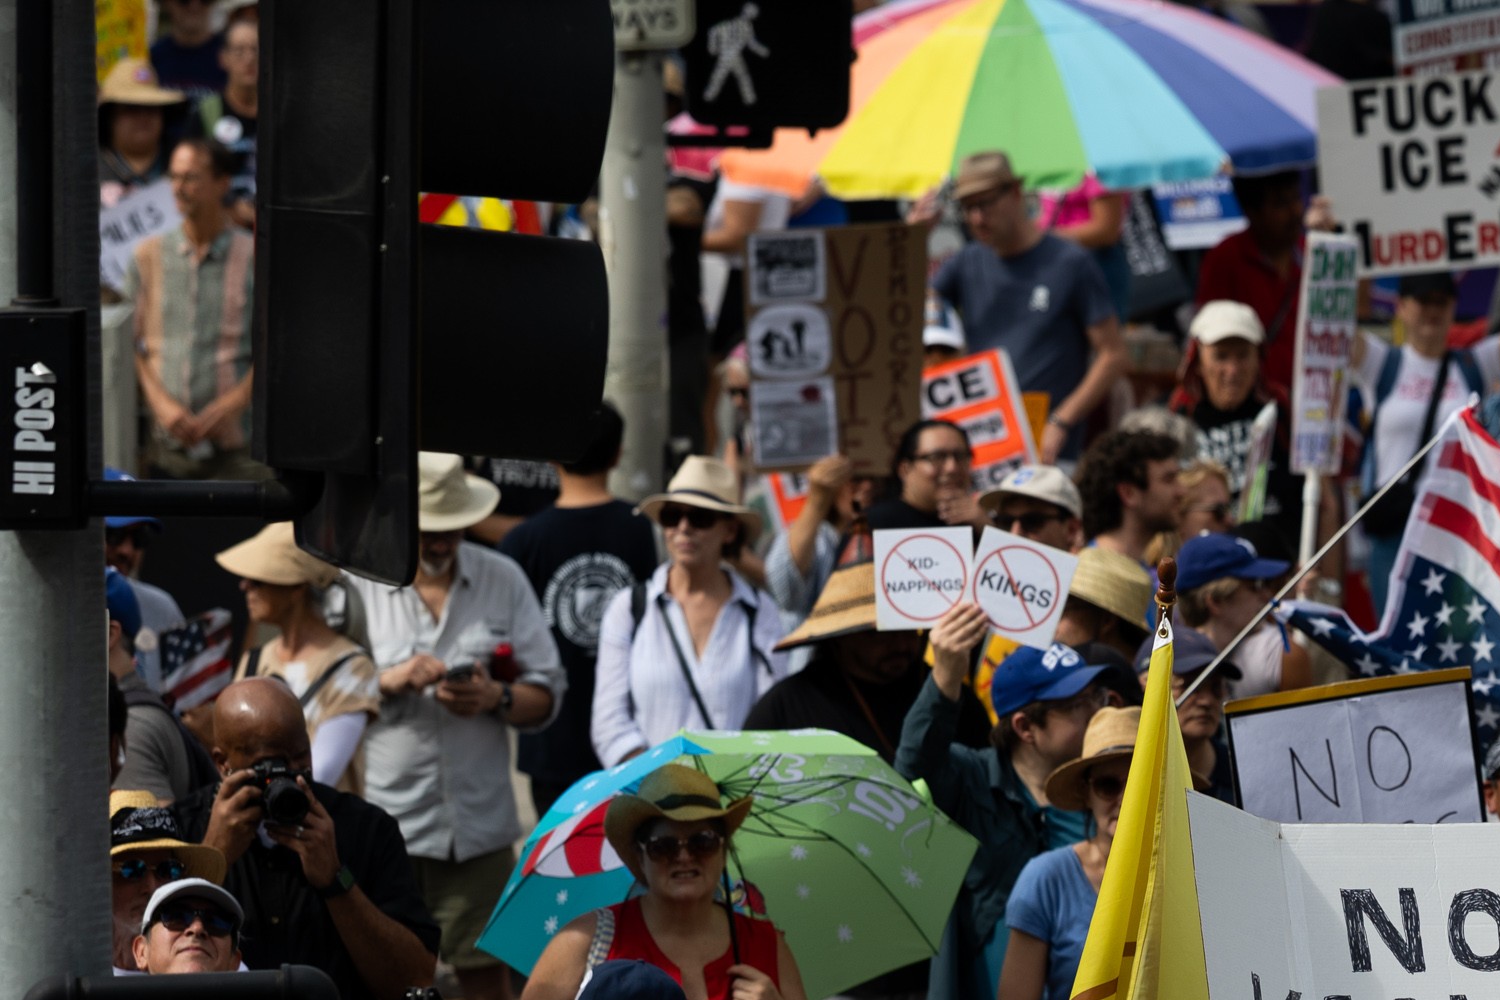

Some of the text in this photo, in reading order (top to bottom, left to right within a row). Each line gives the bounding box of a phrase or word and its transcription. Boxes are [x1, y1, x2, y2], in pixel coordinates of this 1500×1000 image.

[1352, 75, 1496, 136] FUCK
[1380, 137, 1469, 192] ICE
[926, 367, 988, 409] CE
[12, 366, 57, 495] HI POST
[886, 578, 964, 594] NAPPINGS
[907, 556, 940, 571] KID-
[980, 569, 1053, 608] KINGS
[1289, 725, 1412, 822] NO
